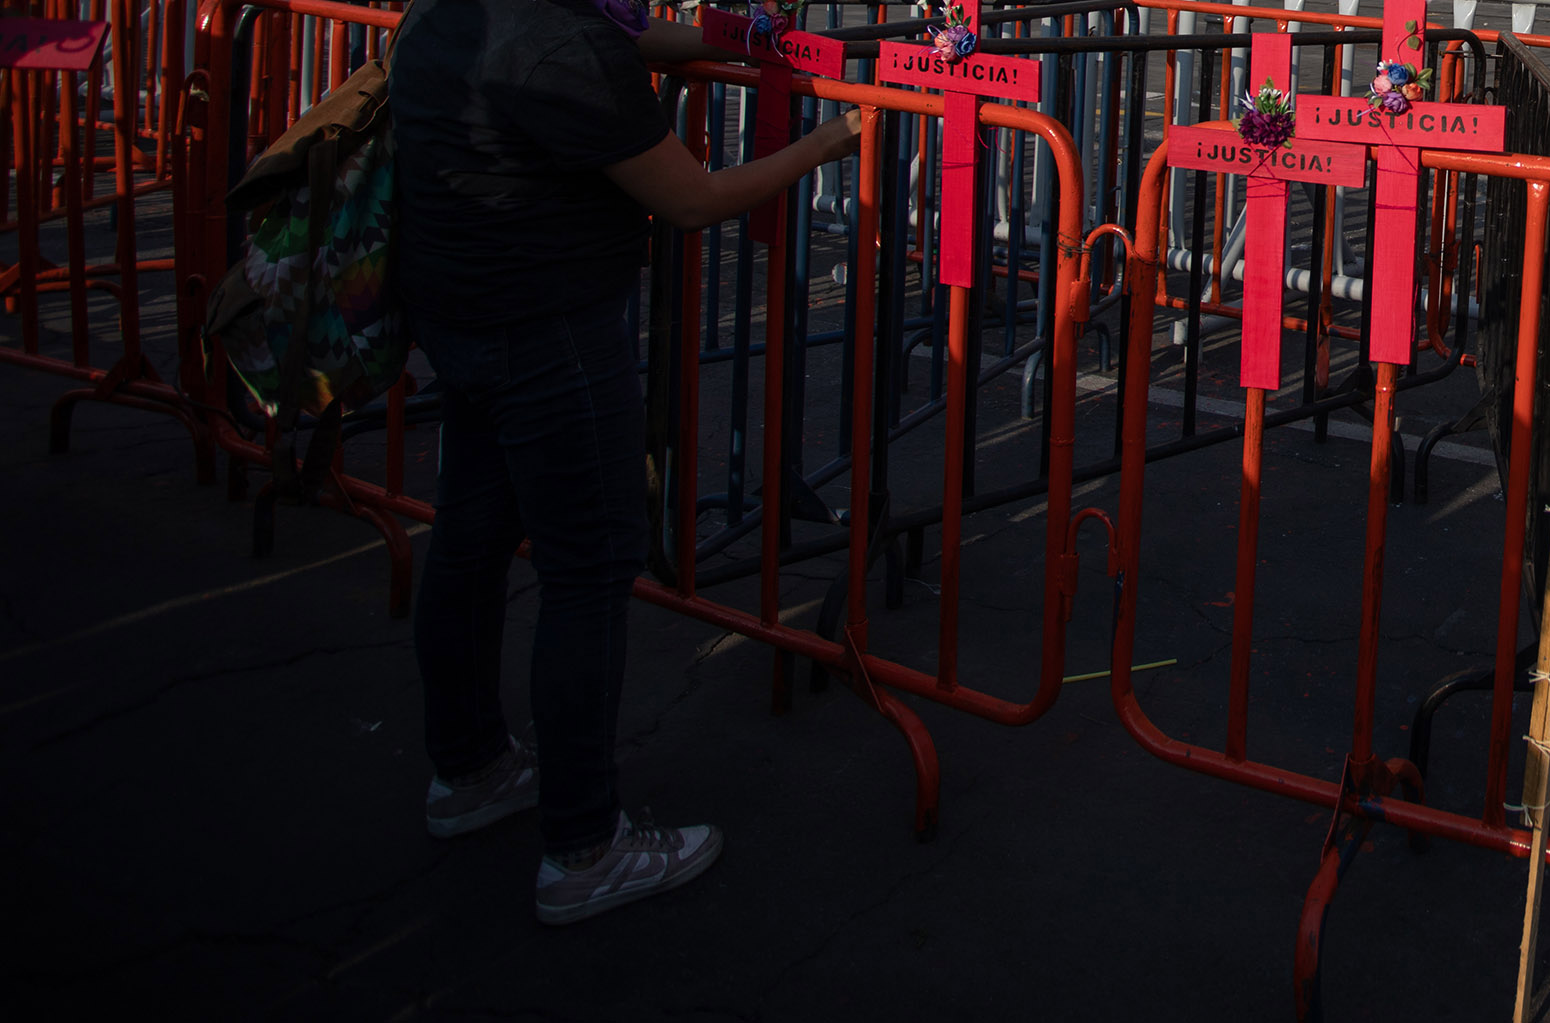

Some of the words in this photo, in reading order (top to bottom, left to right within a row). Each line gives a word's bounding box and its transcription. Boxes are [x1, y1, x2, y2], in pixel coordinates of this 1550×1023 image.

[893, 53, 1017, 84] ¡JUSTICIA!
[1314, 106, 1478, 134] ¡JUSTICIA!
[1197, 142, 1332, 173] ¡JUSTICIA!
